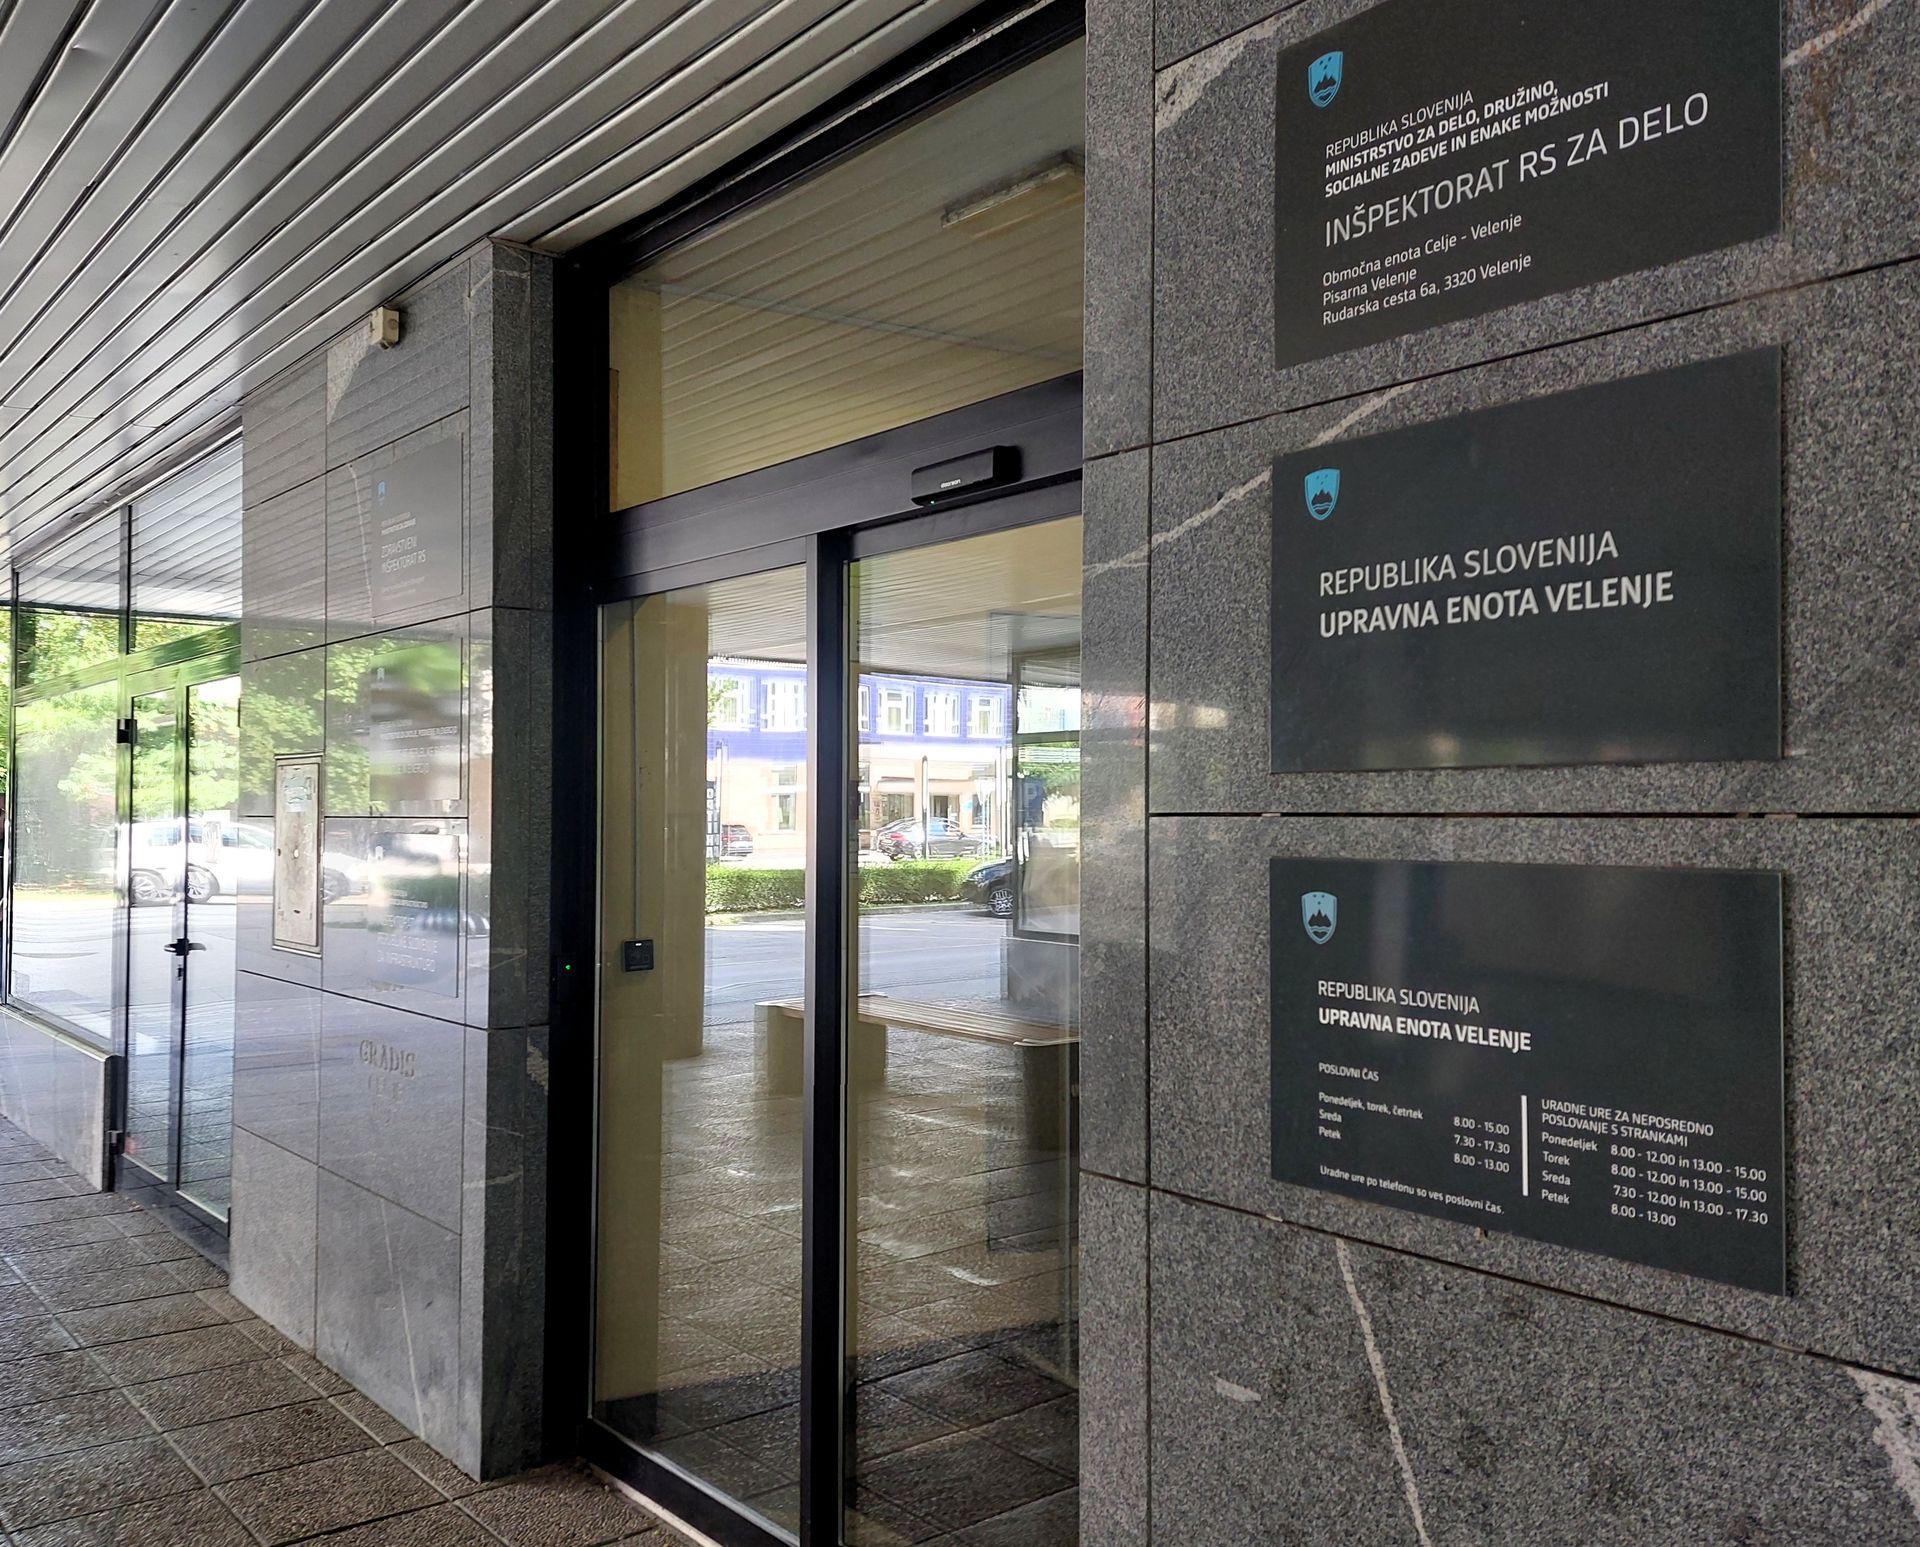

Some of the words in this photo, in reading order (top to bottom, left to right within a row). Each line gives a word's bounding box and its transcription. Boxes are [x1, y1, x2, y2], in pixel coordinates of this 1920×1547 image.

[1325, 133, 1414, 178] MINISTRSTVO
[1417, 125, 1435, 145] ZA
[1438, 109, 1480, 140] DELO,
[1484, 80, 1558, 121] DRUŽINO,
[1325, 163, 1389, 197] SOCIALNE
[1393, 142, 1447, 173] ZADEVE
[1451, 135, 1466, 152] IN
[1470, 115, 1521, 144] ENAKE
[1525, 82, 1609, 127] MOŽNOSTI
[1326, 120, 1398, 159] REPUBLIKA
[1401, 89, 1474, 130] SLOVENIJA
[1325, 160, 1509, 247] INŠPEKTORAT
[1519, 144, 1557, 182] RS
[1567, 128, 1607, 167] ZA
[1619, 92, 1709, 149] DELO
[1323, 257, 1382, 287] Območna
[1384, 246, 1421, 273] enota
[1425, 234, 1458, 259] Celje
[1471, 213, 1522, 243] Velenje
[1323, 282, 1368, 306] Pisarna
[1371, 266, 1417, 296] Velenje
[1323, 300, 1380, 325] Rudarska
[1383, 291, 1416, 310] cesta
[1420, 280, 1440, 300] 6a,
[1444, 268, 1476, 291] 3320
[1480, 253, 1532, 281] Velenje
[1319, 553, 1457, 597] REPUBLIKA
[1464, 530, 1619, 579] SLOVENIJA
[1320, 601, 1439, 638] UPRAVNA
[1447, 588, 1539, 625] ENOTA
[1544, 571, 1674, 613] VELENJE
[1318, 981, 1396, 1004] REPUBLIKA
[1400, 989, 1480, 1015] SLOVENIJA
[1318, 1008, 1393, 1033] UPRAVNA
[1397, 1016, 1452, 1040] ENOTA
[1455, 1025, 1531, 1053] VELENJE
[1319, 1062, 1360, 1078] POSLOVNI
[1362, 1068, 1379, 1081] ČAS
[1319, 1092, 1365, 1111] Ponedeljek,
[1367, 1100, 1391, 1115] torek,
[1393, 1105, 1423, 1120] četrtek
[1319, 1109, 1342, 1122] Sreda
[1454, 1116, 1475, 1130] 8.00
[1484, 1121, 1509, 1135] 15.00
[1542, 1099, 1586, 1116] URADNE
[1589, 1107, 1611, 1120] URE
[1615, 1110, 1629, 1123] ZA
[1632, 1113, 1714, 1136] NEPOSREDNO
[1319, 1127, 1341, 1140] Petek
[1454, 1135, 1475, 1148] 7.30
[1484, 1140, 1510, 1154] 17.30
[1542, 1113, 1608, 1134] POSLOVANJE
[1611, 1124, 1618, 1135] S
[1621, 1126, 1688, 1147] STRANKAMI
[1454, 1153, 1475, 1167] 8.00
[1484, 1158, 1509, 1173] 13.00
[1542, 1132, 1598, 1152] Ponedeljek
[1611, 1145, 1635, 1158] 8.00
[1646, 1151, 1675, 1166] 12.00
[1679, 1157, 1689, 1168] in
[1693, 1158, 1722, 1174] 13.00
[1734, 1166, 1766, 1182] 15.00
[1543, 1151, 1570, 1166] Torek
[1611, 1164, 1635, 1178] 8.00
[1647, 1171, 1676, 1186] 12.00
[1679, 1177, 1690, 1188] in
[1693, 1178, 1723, 1194] 13.00
[1735, 1186, 1767, 1202] 15.00
[1320, 1165, 1349, 1180] Uradne
[1351, 1174, 1365, 1184] ure
[1367, 1177, 1377, 1187] po
[1379, 1179, 1415, 1195] telefonu
[1417, 1188, 1427, 1197] so
[1429, 1191, 1443, 1201] ves
[1445, 1193, 1483, 1210] poslovni
[1485, 1200, 1504, 1214] čas.
[1542, 1170, 1571, 1185] Sreda
[1647, 1191, 1676, 1206] 12.00
[1680, 1198, 1690, 1209] in
[1693, 1200, 1723, 1216] 13.00
[1735, 1208, 1768, 1224] 17.30
[1542, 1189, 1570, 1205] Petek
[1611, 1204, 1635, 1218] 8.00
[1647, 1211, 1676, 1226] 13.00
